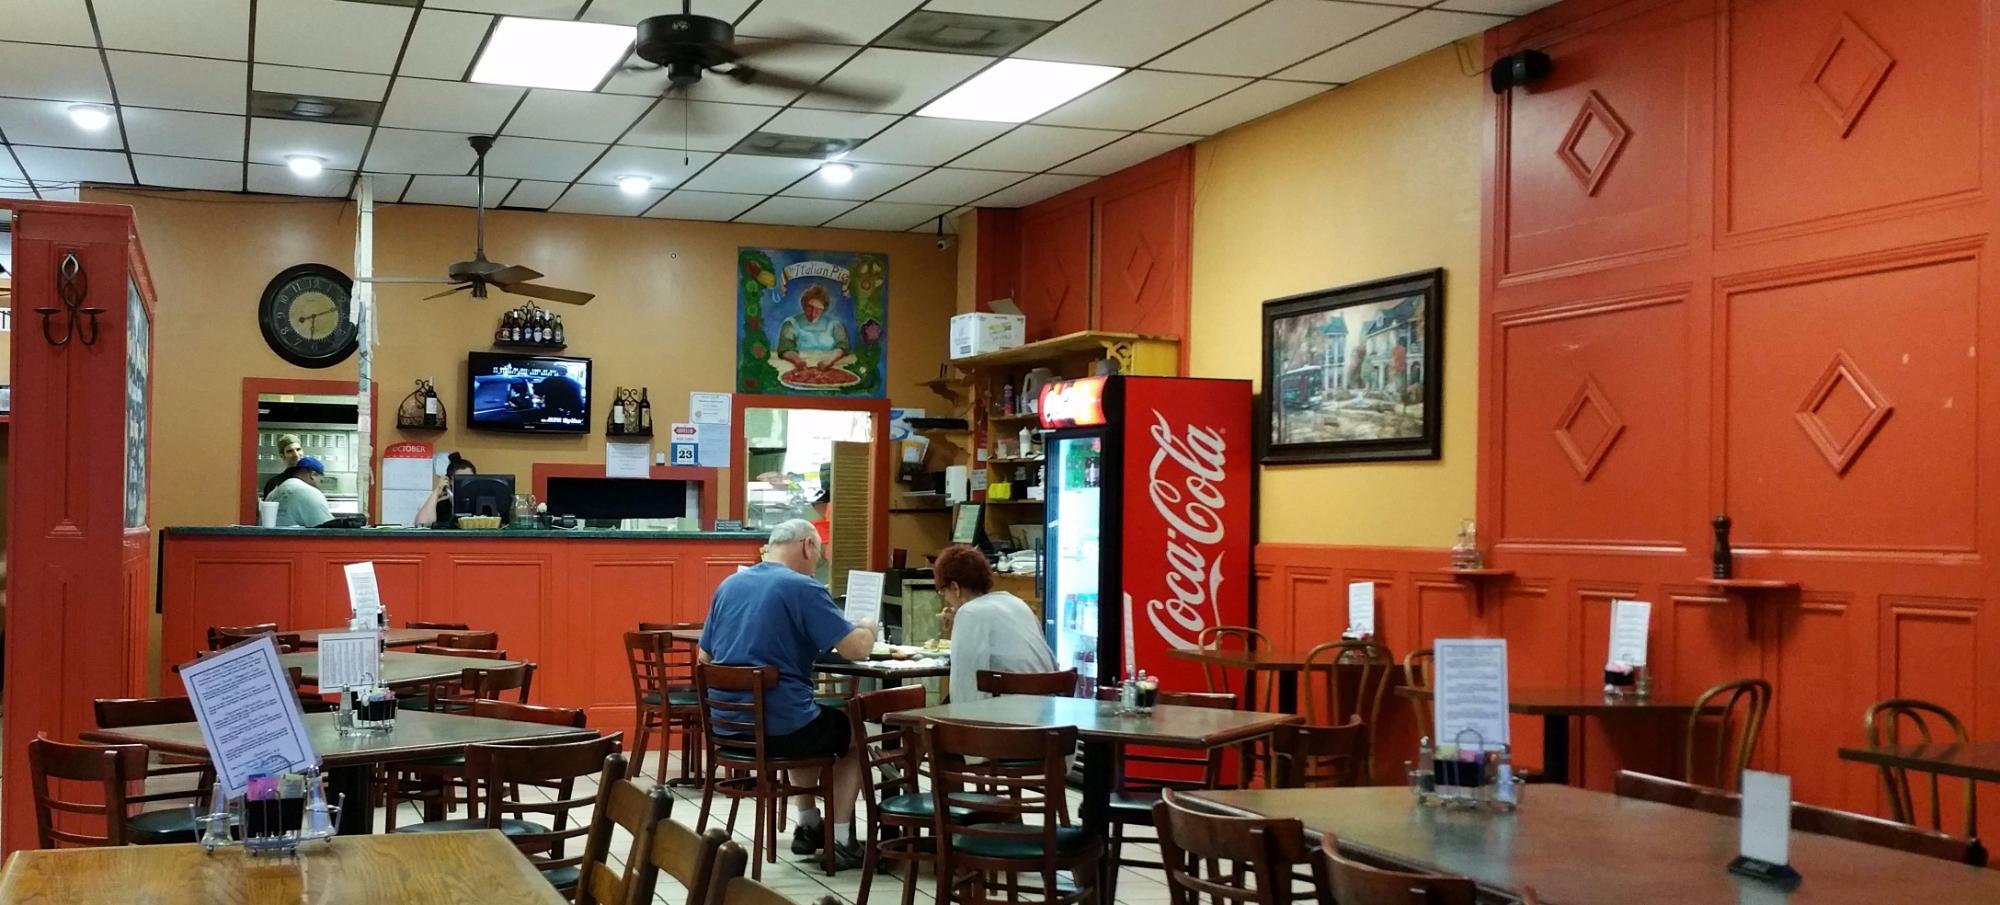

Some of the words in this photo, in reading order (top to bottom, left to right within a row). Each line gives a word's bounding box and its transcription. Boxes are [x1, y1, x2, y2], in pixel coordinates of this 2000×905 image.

[794, 262, 829, 277] Italian
[830, 264, 849, 282] Pie
[308, 279, 320, 289] 12
[280, 294, 289, 304] 10
[392, 445, 426, 453] OCTOBER
[678, 449, 694, 459] 23
[1147, 408, 1227, 651] Coca-Cola
